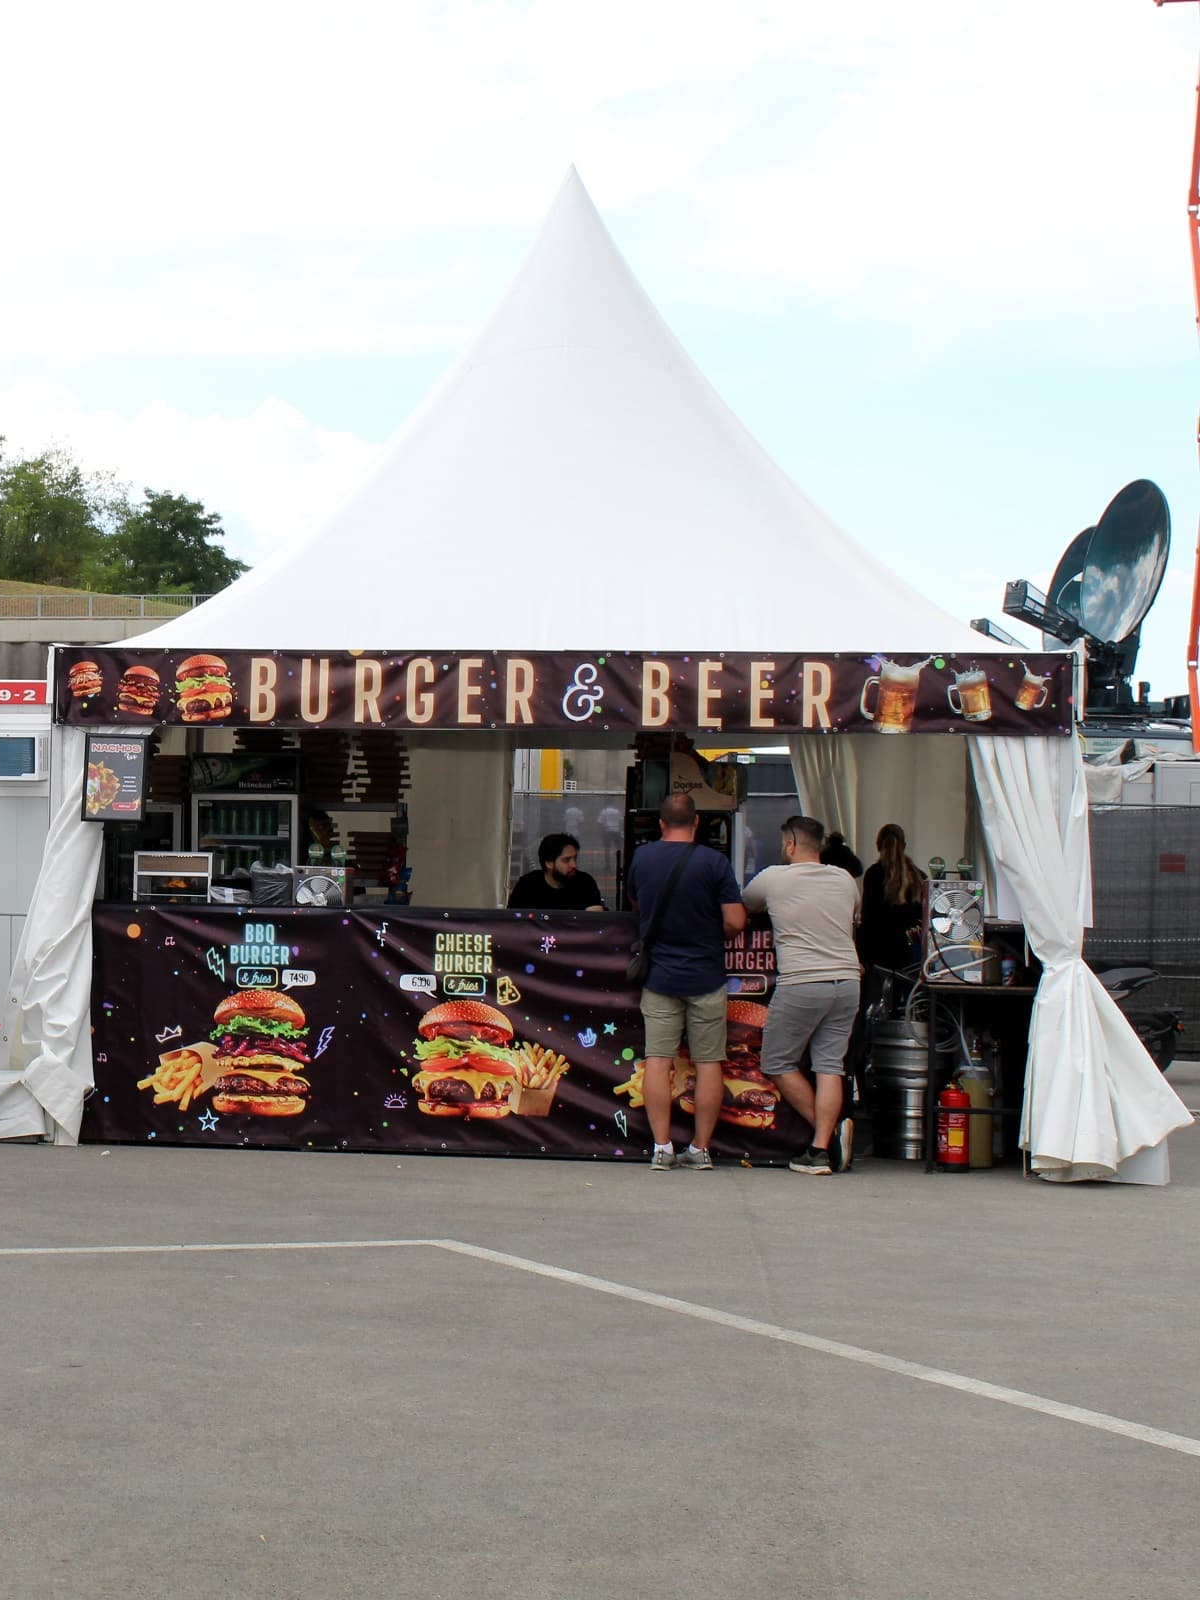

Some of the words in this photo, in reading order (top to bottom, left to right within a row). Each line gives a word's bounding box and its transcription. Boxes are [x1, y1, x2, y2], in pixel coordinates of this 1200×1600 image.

[248, 657, 535, 724] BURGER
[561, 662, 604, 722] &
[641, 660, 833, 728] BEER
[91, 742, 142, 754] NACHOS
[244, 923, 276, 945] BBQ
[435, 933, 493, 953] CHEESE
[752, 930, 775, 949] HE
[229, 945, 290, 965] BURGER
[434, 953, 493, 974] BURGER
[724, 951, 775, 970] URGER
[248, 971, 272, 986] fries
[453, 978, 479, 993] fries
